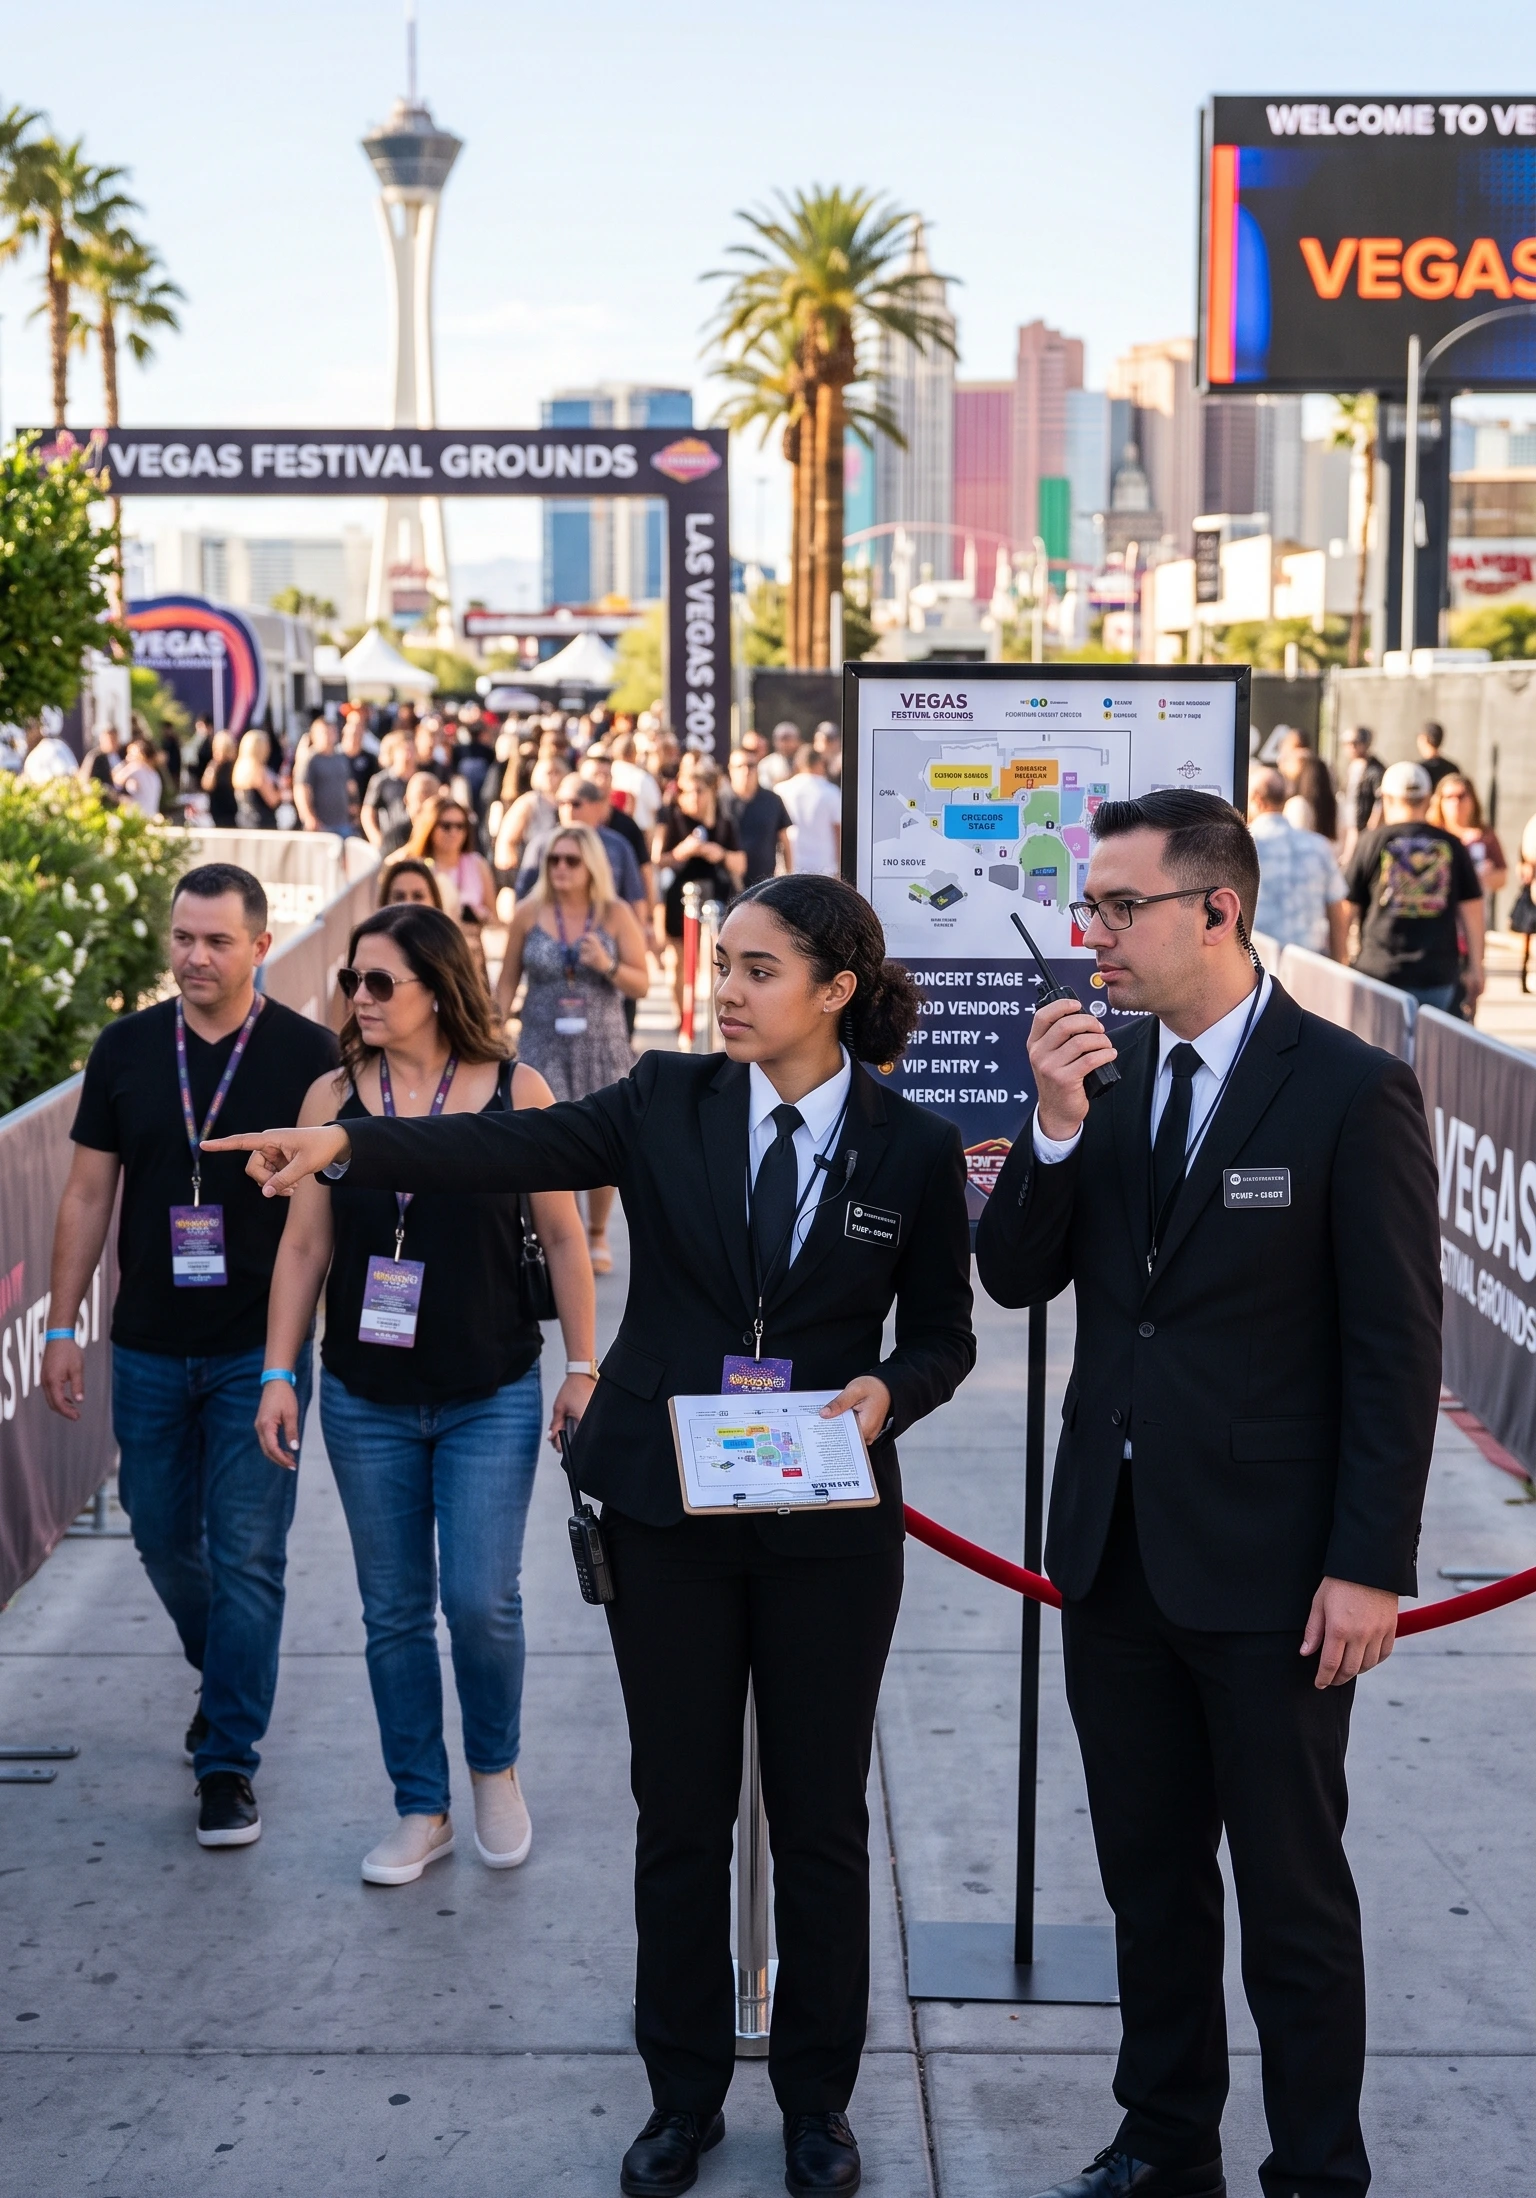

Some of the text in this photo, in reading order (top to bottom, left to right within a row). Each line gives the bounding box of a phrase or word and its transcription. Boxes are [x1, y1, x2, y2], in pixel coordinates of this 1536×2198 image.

[1266, 104, 1435, 135] WELCOME
[1439, 104, 1488, 135] TO
[1299, 236, 1536, 300] VEGAS
[108, 443, 638, 478] VEGAS FESTIVAL GROUNDS
[130, 630, 226, 658] VEGAS
[685, 513, 715, 758] LAS VEGAS 202
[900, 693, 968, 709] VEGAS
[933, 711, 974, 719] GROUNDS
[976, 972, 1023, 986] STAGE
[948, 1001, 1020, 1015] VENDORS
[932, 1030, 981, 1044] ENTRY
[902, 1059, 980, 1074] VIP ENTRY
[902, 1088, 1008, 1103] MERCH STAND
[1434, 1106, 1536, 1283] VEGAS
[1477, 1268, 1536, 1354] GROUNDS
